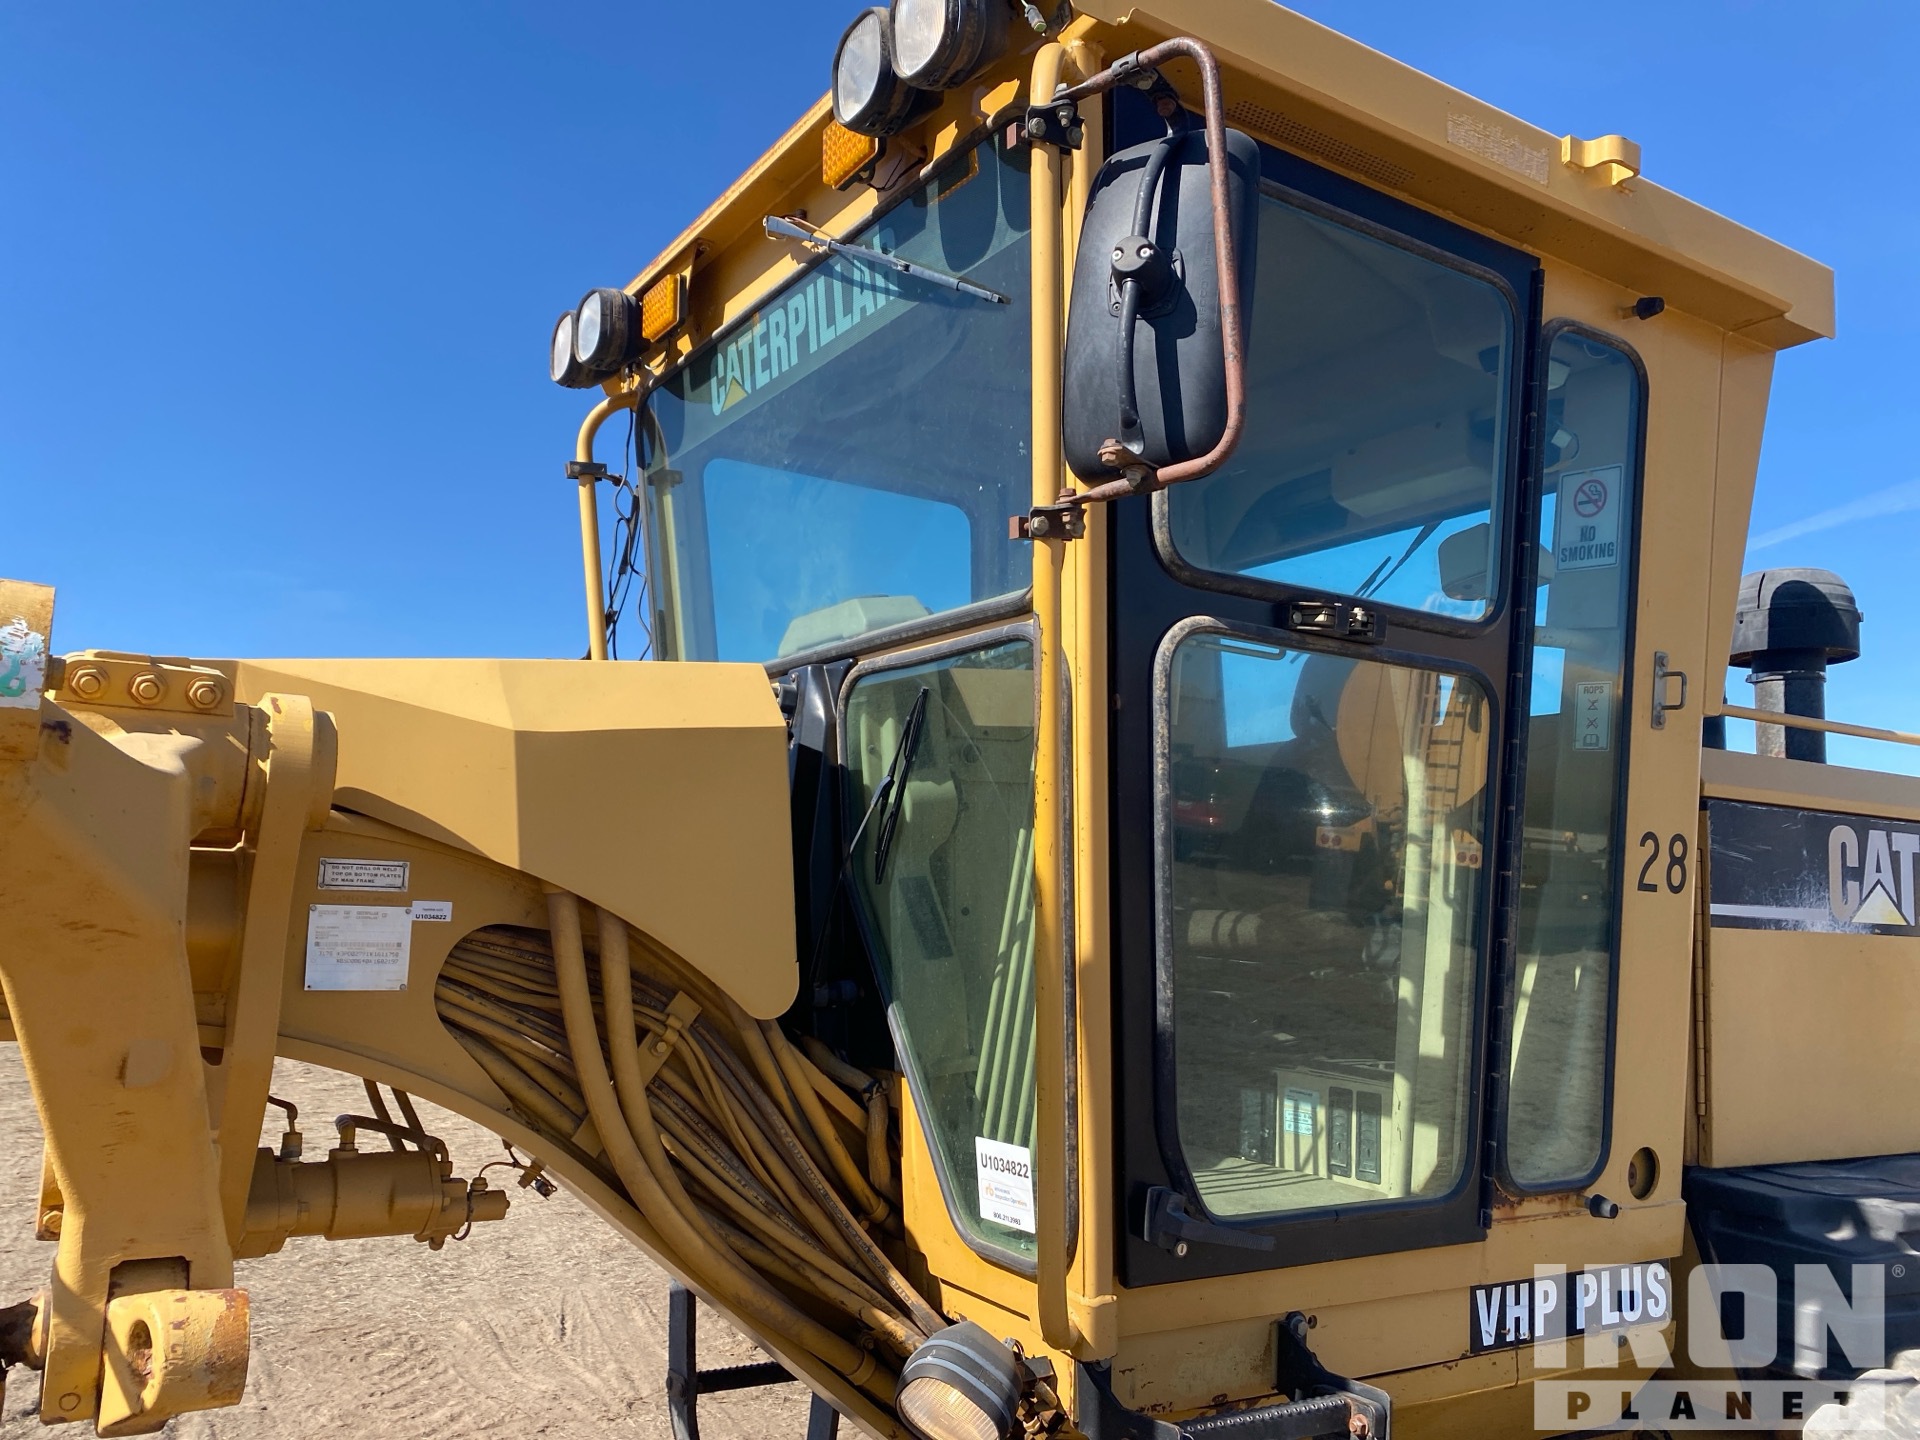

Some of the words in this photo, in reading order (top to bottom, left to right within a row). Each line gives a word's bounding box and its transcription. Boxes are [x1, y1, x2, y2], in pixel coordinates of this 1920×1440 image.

[1580, 525, 1596, 543] NO
[1560, 542, 1615, 562] SMOKING
[1583, 685, 1604, 694] ROPS
[1637, 831, 1688, 894] 28
[1828, 825, 1920, 926] CAT
[980, 1152, 1030, 1178] U1034822
[1475, 1279, 1558, 1347] VHP
[1575, 1262, 1668, 1330] PLUS
